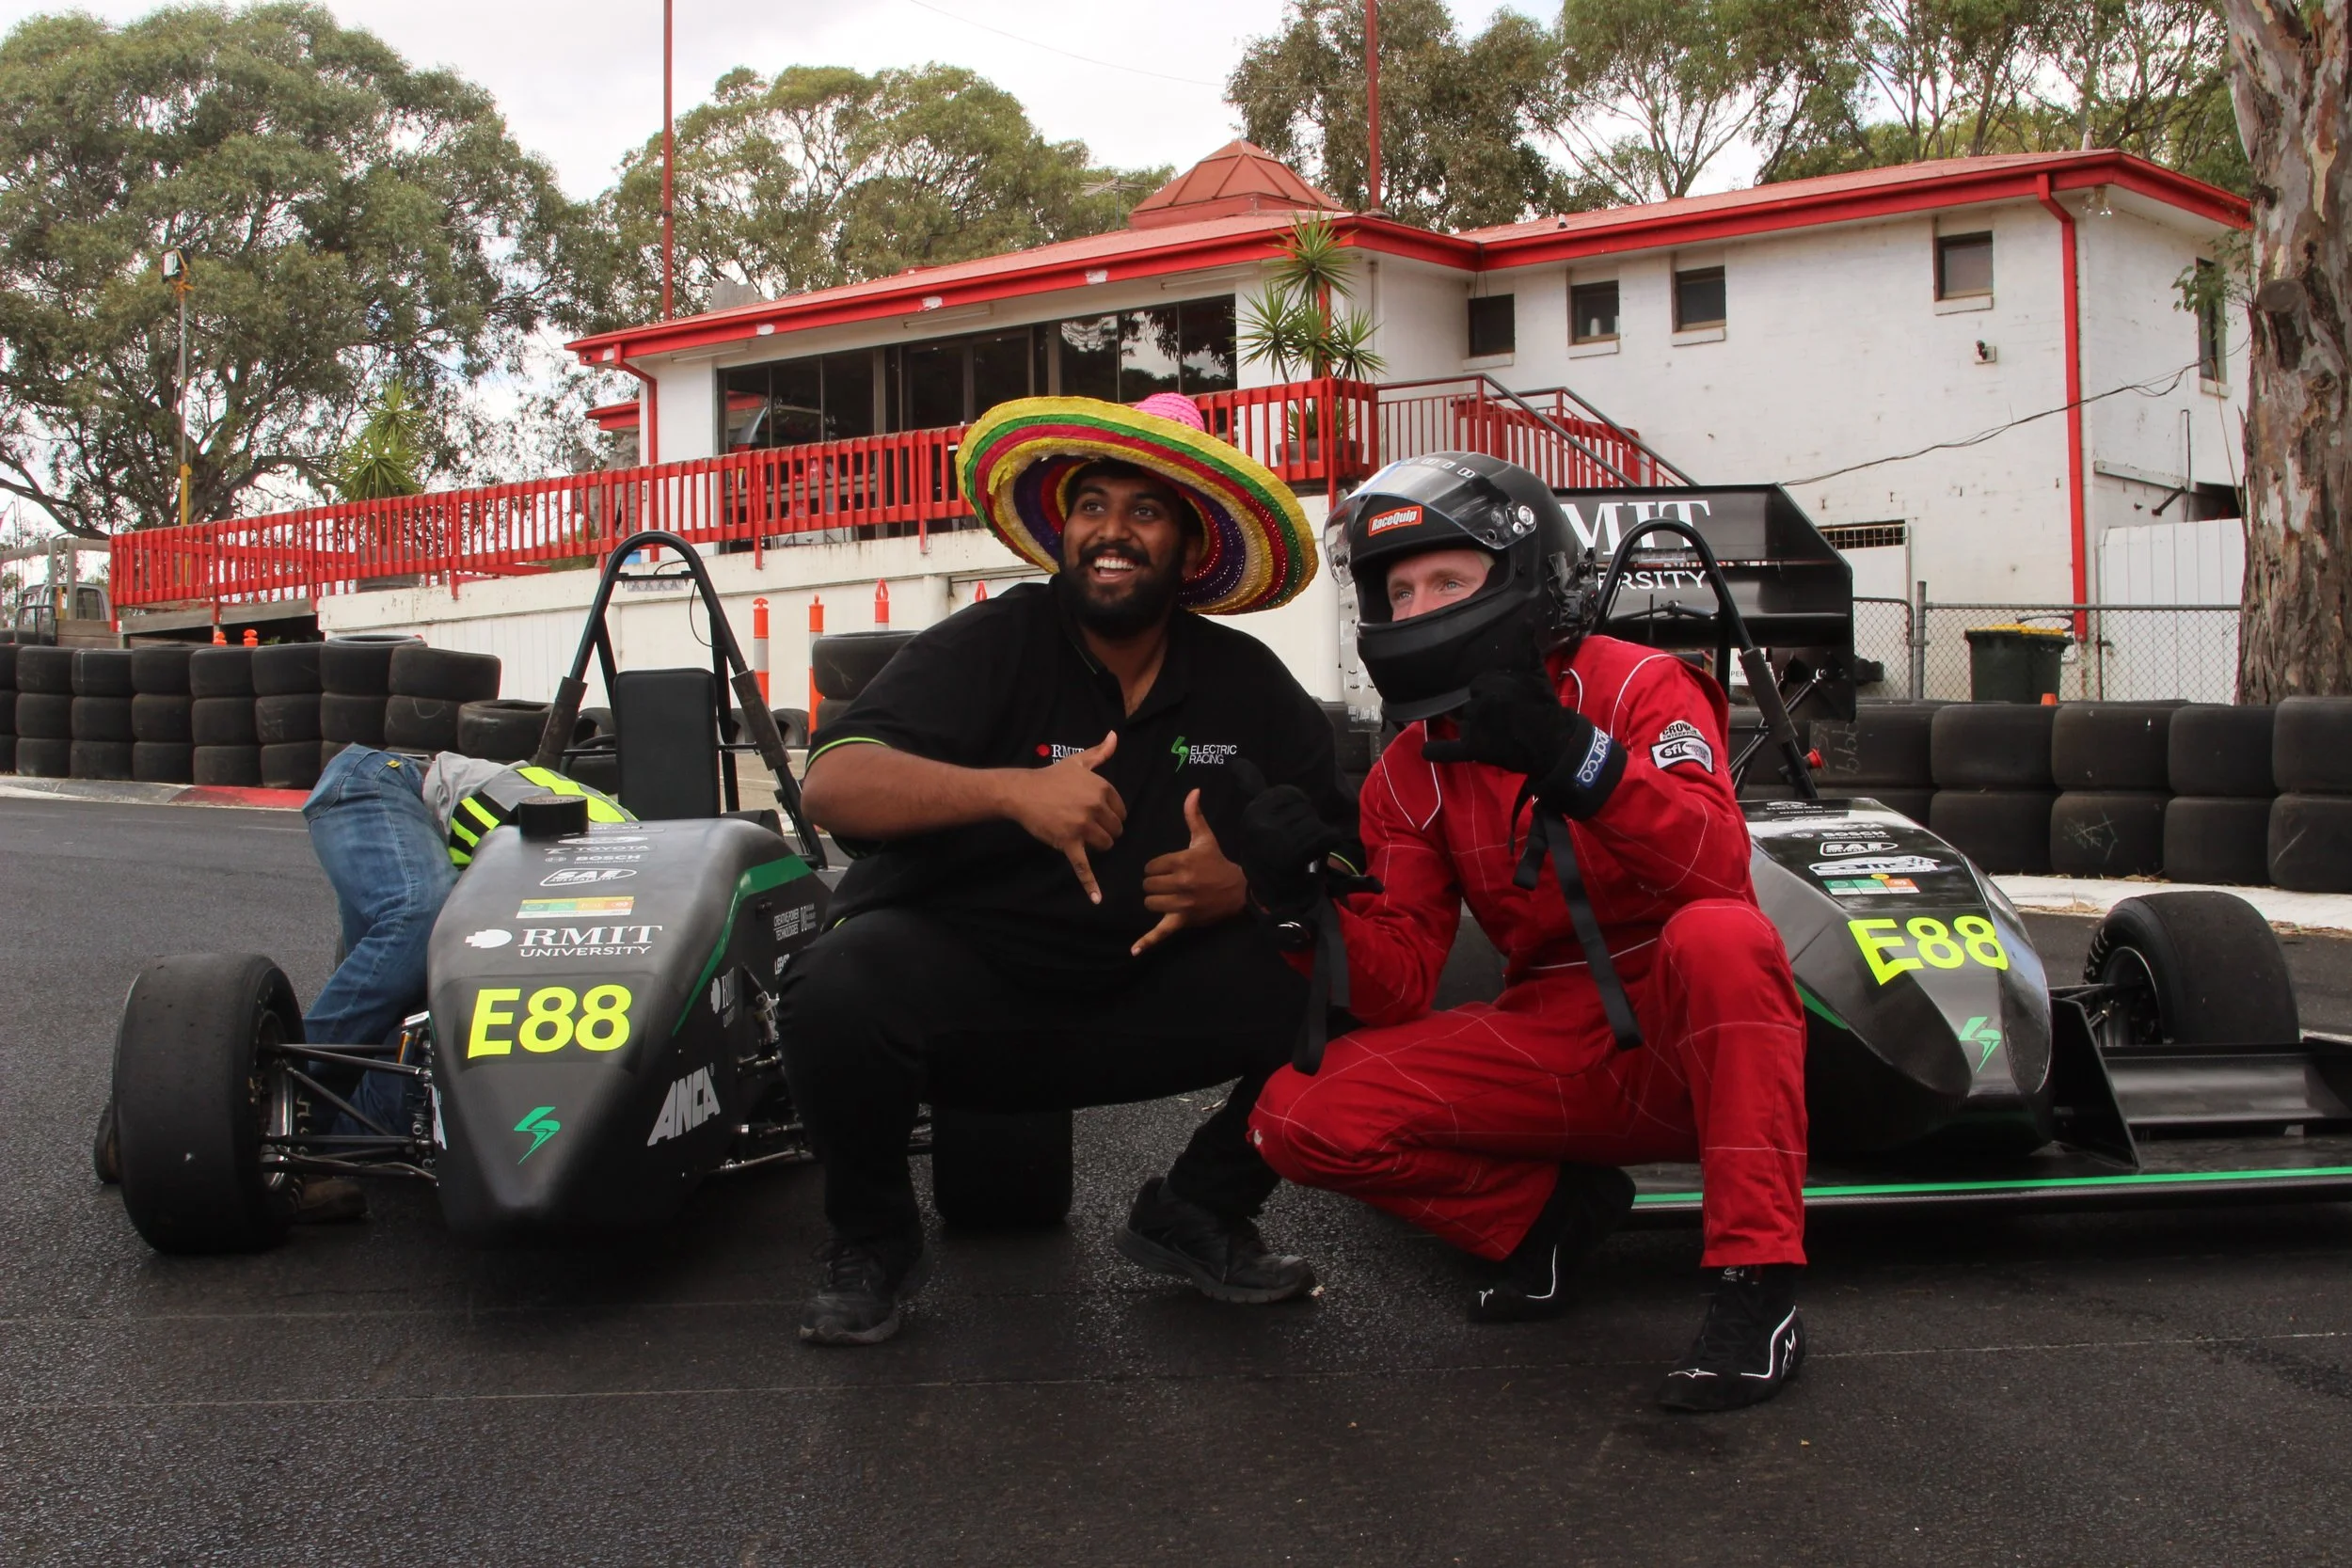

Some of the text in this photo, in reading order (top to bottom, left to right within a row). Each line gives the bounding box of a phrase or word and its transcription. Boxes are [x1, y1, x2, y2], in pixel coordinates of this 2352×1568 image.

[1371, 510, 1418, 531] RaceQuip
[1189, 753, 1224, 765] RACING
[1190, 744, 1237, 755] ELECTRIC
[518, 926, 662, 946] RMIT
[519, 945, 652, 958] UNIVERSITY
[1848, 915, 2009, 986] E88
[468, 984, 632, 1059] E88
[646, 1066, 721, 1147] ANCA
